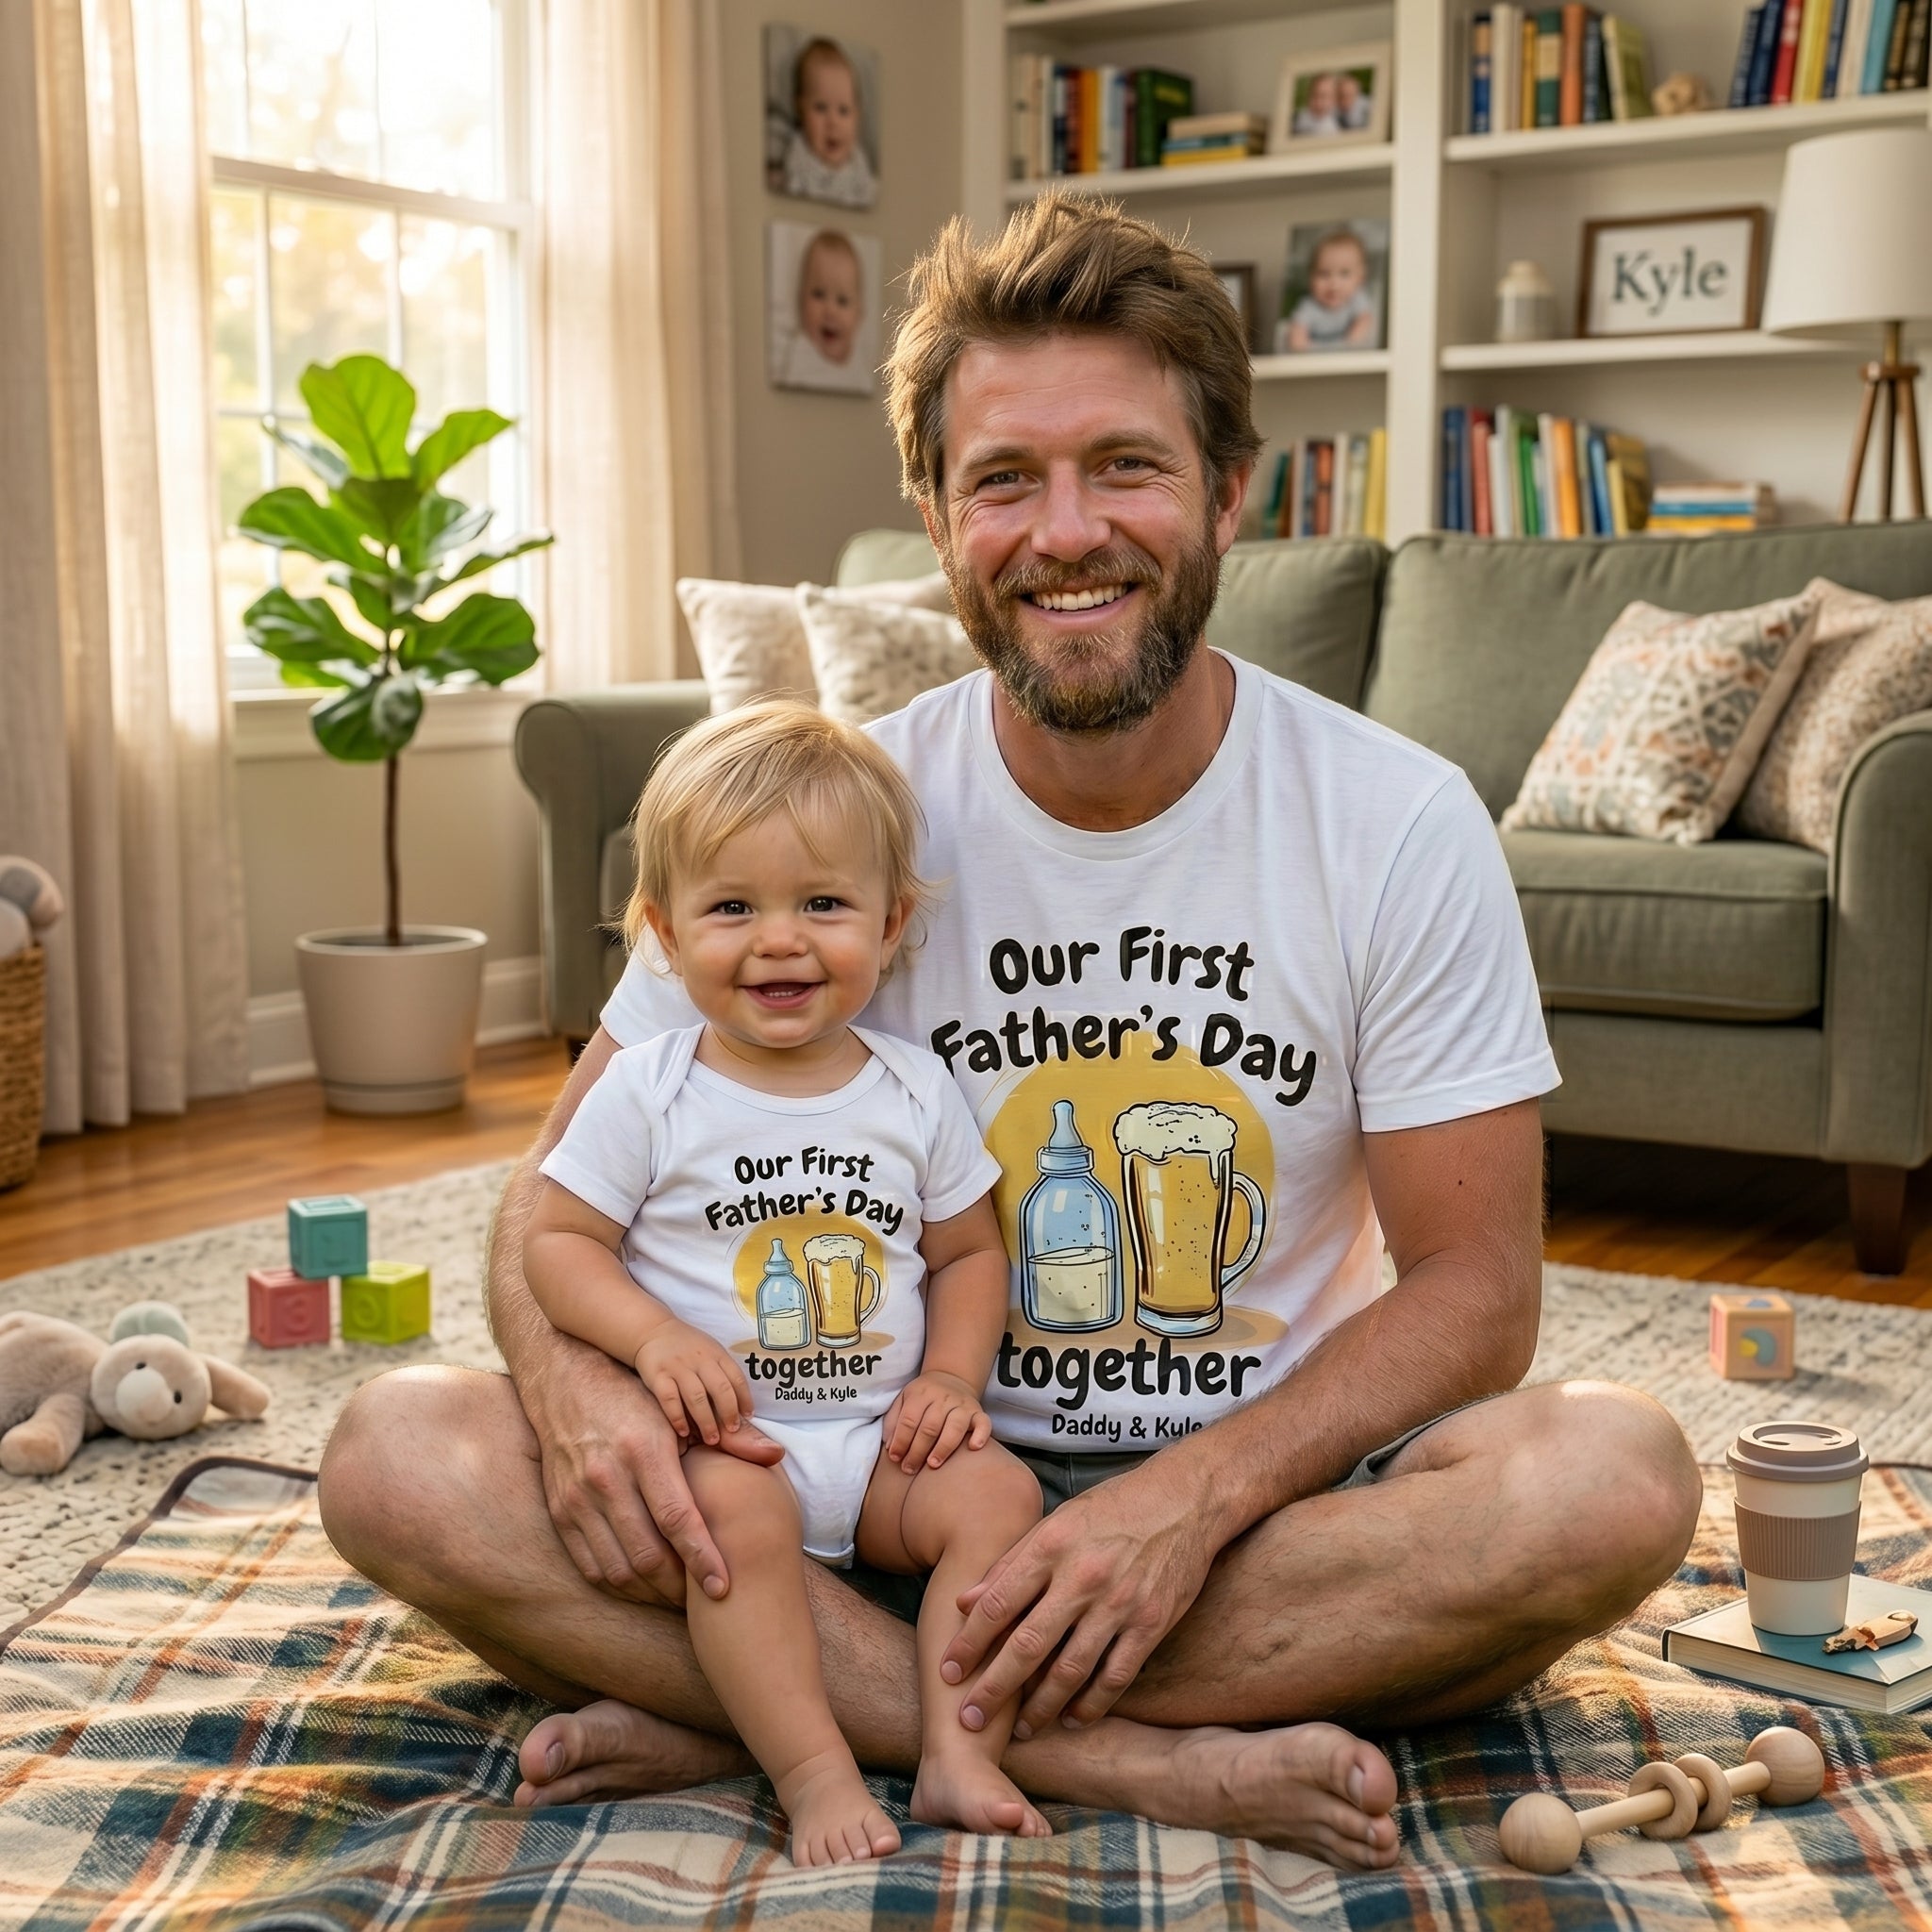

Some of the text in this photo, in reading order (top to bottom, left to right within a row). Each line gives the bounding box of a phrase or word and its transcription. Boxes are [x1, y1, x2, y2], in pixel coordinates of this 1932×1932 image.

[1612, 245, 1728, 317] Kyle
[990, 925, 1255, 1001] Our First
[930, 1005, 1317, 1107] Father's Day
[734, 1145, 874, 1185] Our First
[705, 1186, 904, 1236] Father's Day
[744, 1350, 882, 1388] together
[998, 1331, 1261, 1409] together
[774, 1386, 858, 1404] Daddy & Kyle
[1053, 1413, 1121, 1441] Daddy
[1128, 1416, 1147, 1439] &
